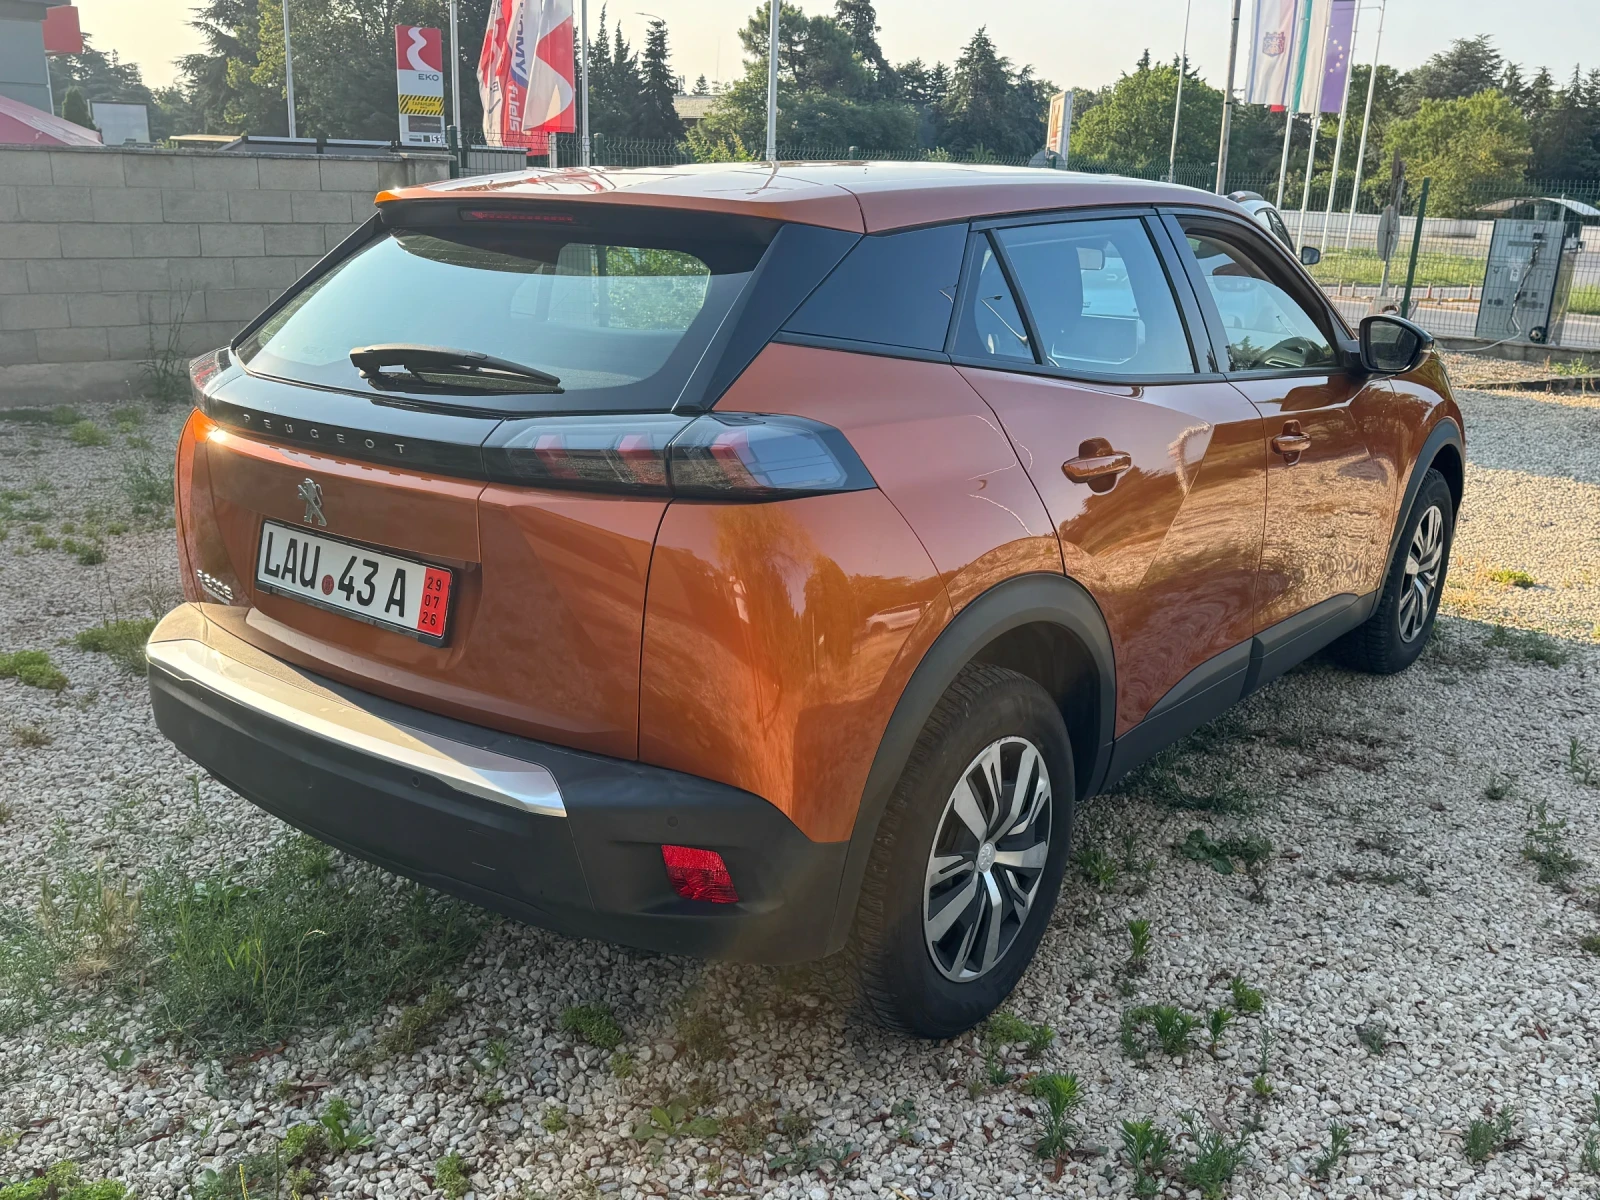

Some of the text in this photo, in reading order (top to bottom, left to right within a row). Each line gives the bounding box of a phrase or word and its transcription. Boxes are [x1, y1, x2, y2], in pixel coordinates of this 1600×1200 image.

[418, 73, 439, 81] EKO
[508, 84, 521, 132] fuels
[243, 413, 405, 454] PEUGEOT
[264, 532, 321, 590] LAU
[337, 556, 379, 607] 43
[384, 568, 406, 618] A
[427, 576, 442, 592] 29
[424, 594, 440, 609] 07
[421, 611, 437, 626] 26
